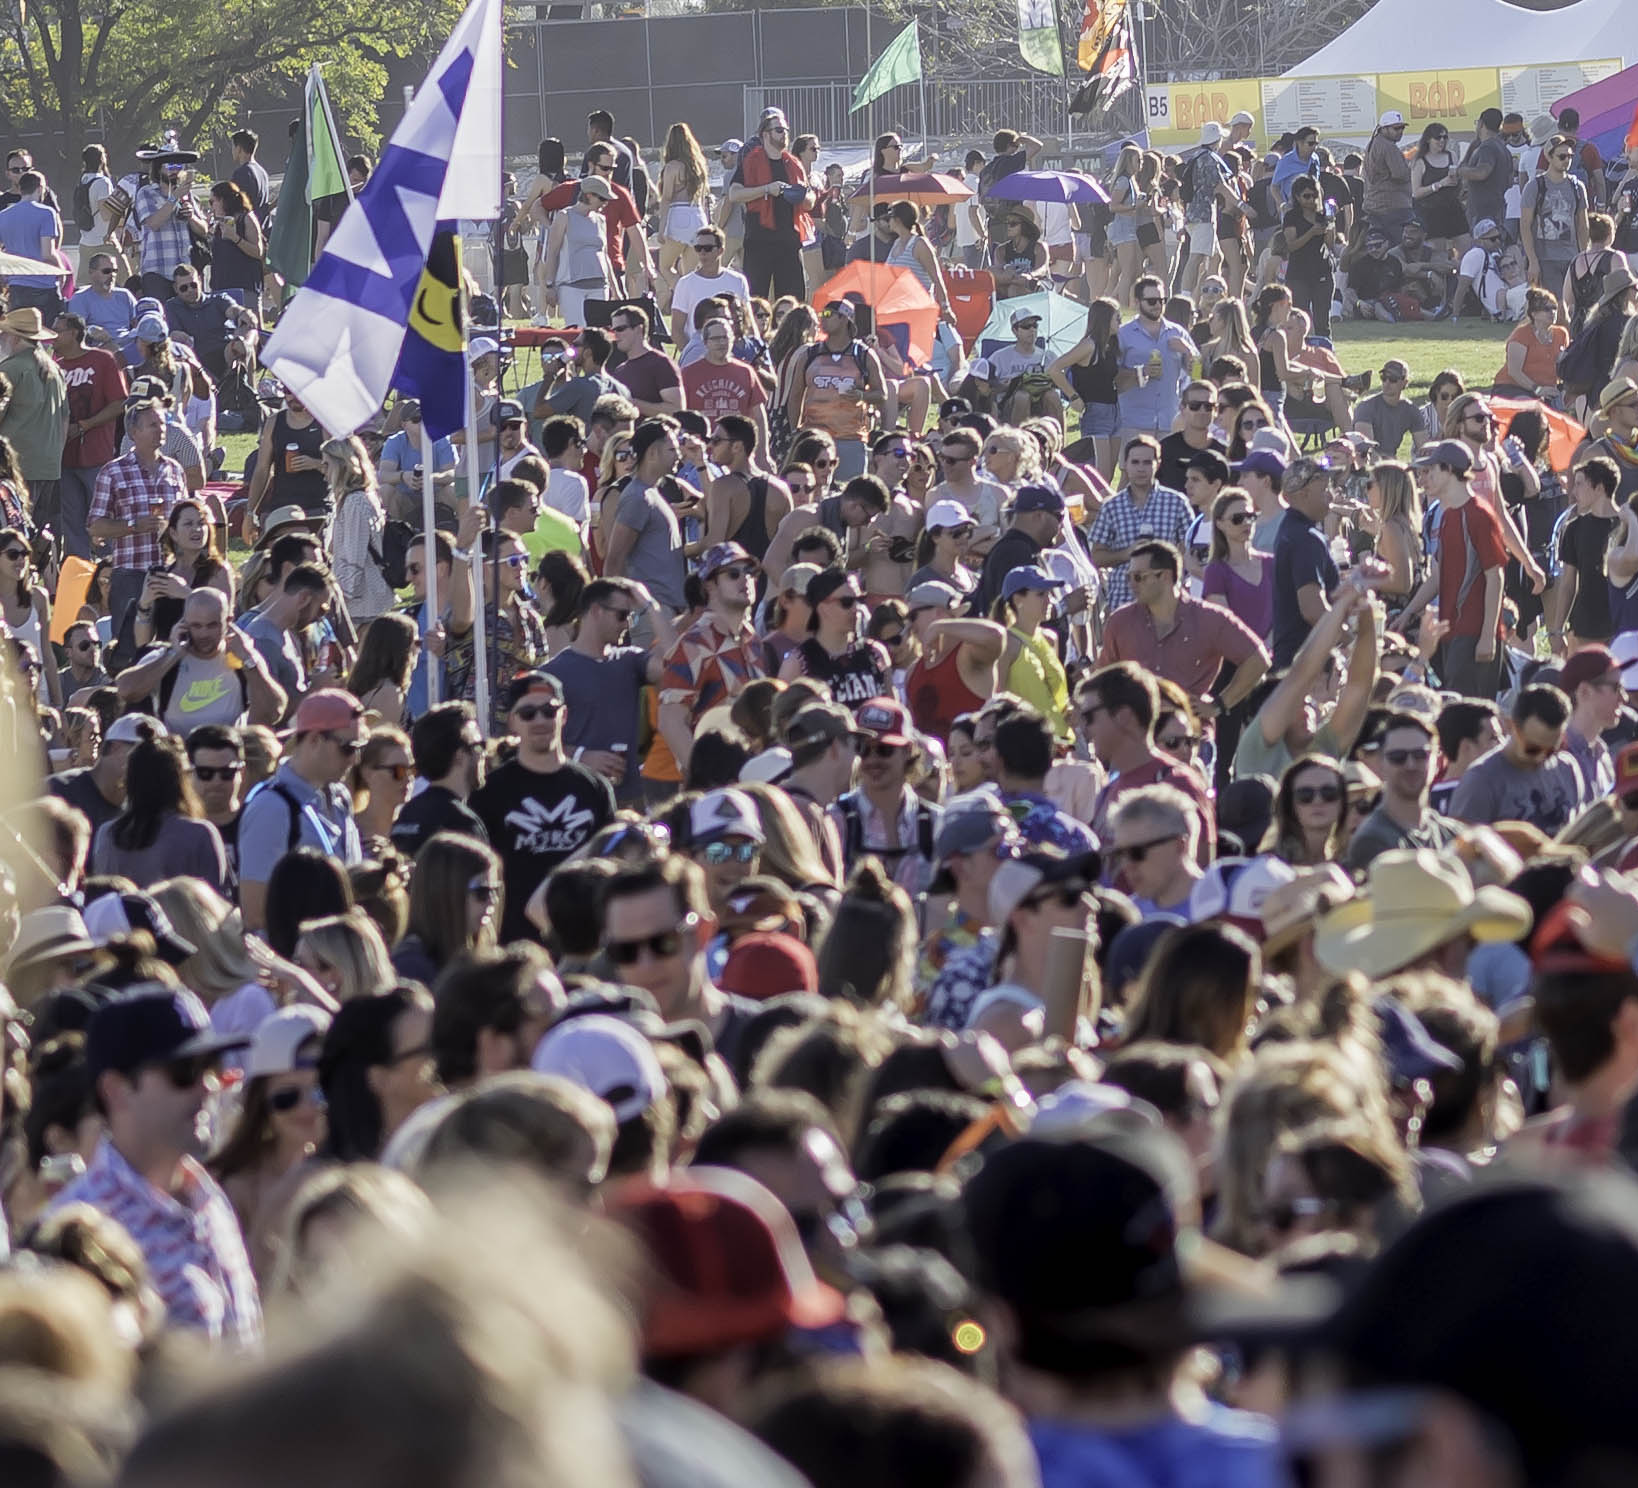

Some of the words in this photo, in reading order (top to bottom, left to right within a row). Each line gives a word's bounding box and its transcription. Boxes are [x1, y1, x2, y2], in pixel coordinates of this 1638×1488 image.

[1150, 96, 1168, 117] B5
[1175, 92, 1230, 131] BAR
[1409, 79, 1467, 119] BAR
[1043, 159, 1062, 171] ATM
